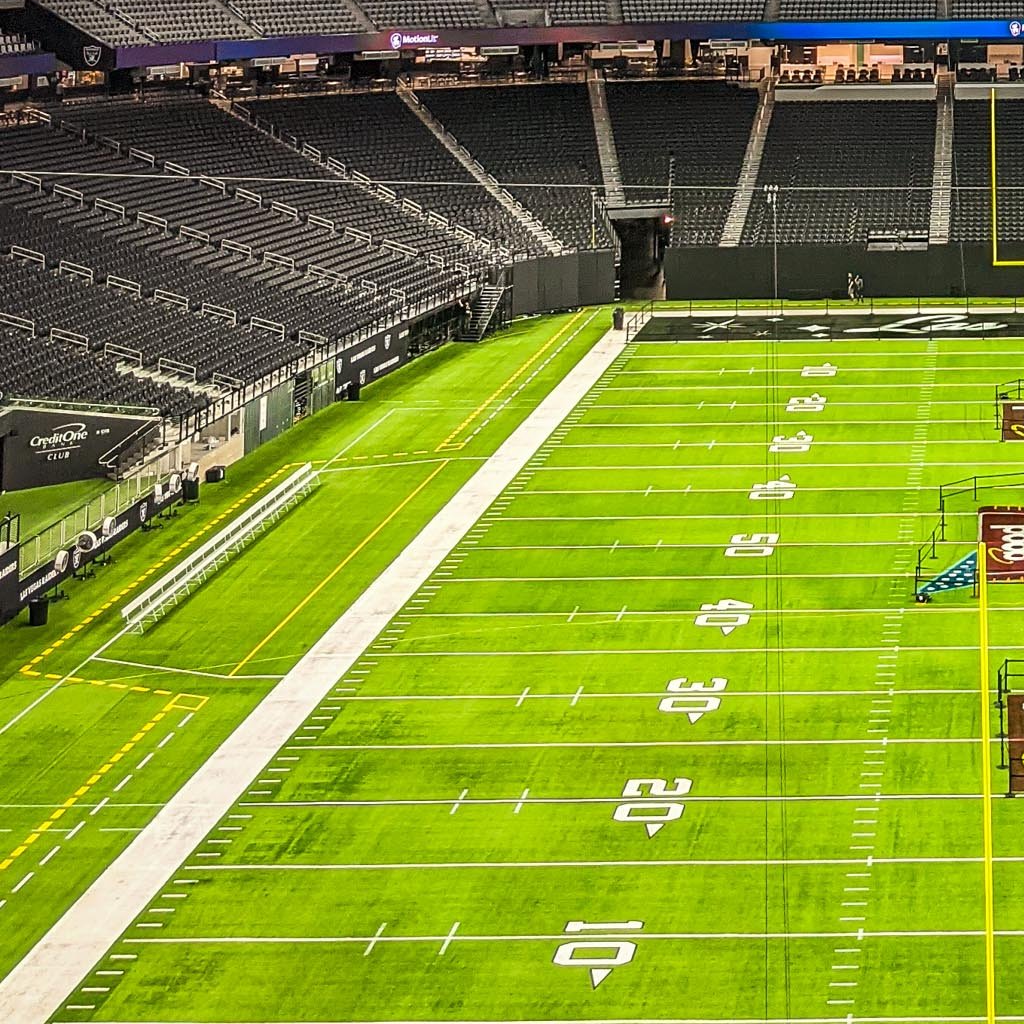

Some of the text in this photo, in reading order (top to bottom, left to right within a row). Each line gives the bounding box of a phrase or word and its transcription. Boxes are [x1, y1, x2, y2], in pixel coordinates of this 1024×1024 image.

[47, 451, 70, 461] CLUB
[724, 532, 780, 557] 50
[657, 677, 729, 713] 30
[612, 778, 694, 822] 20
[551, 920, 645, 966] 10
